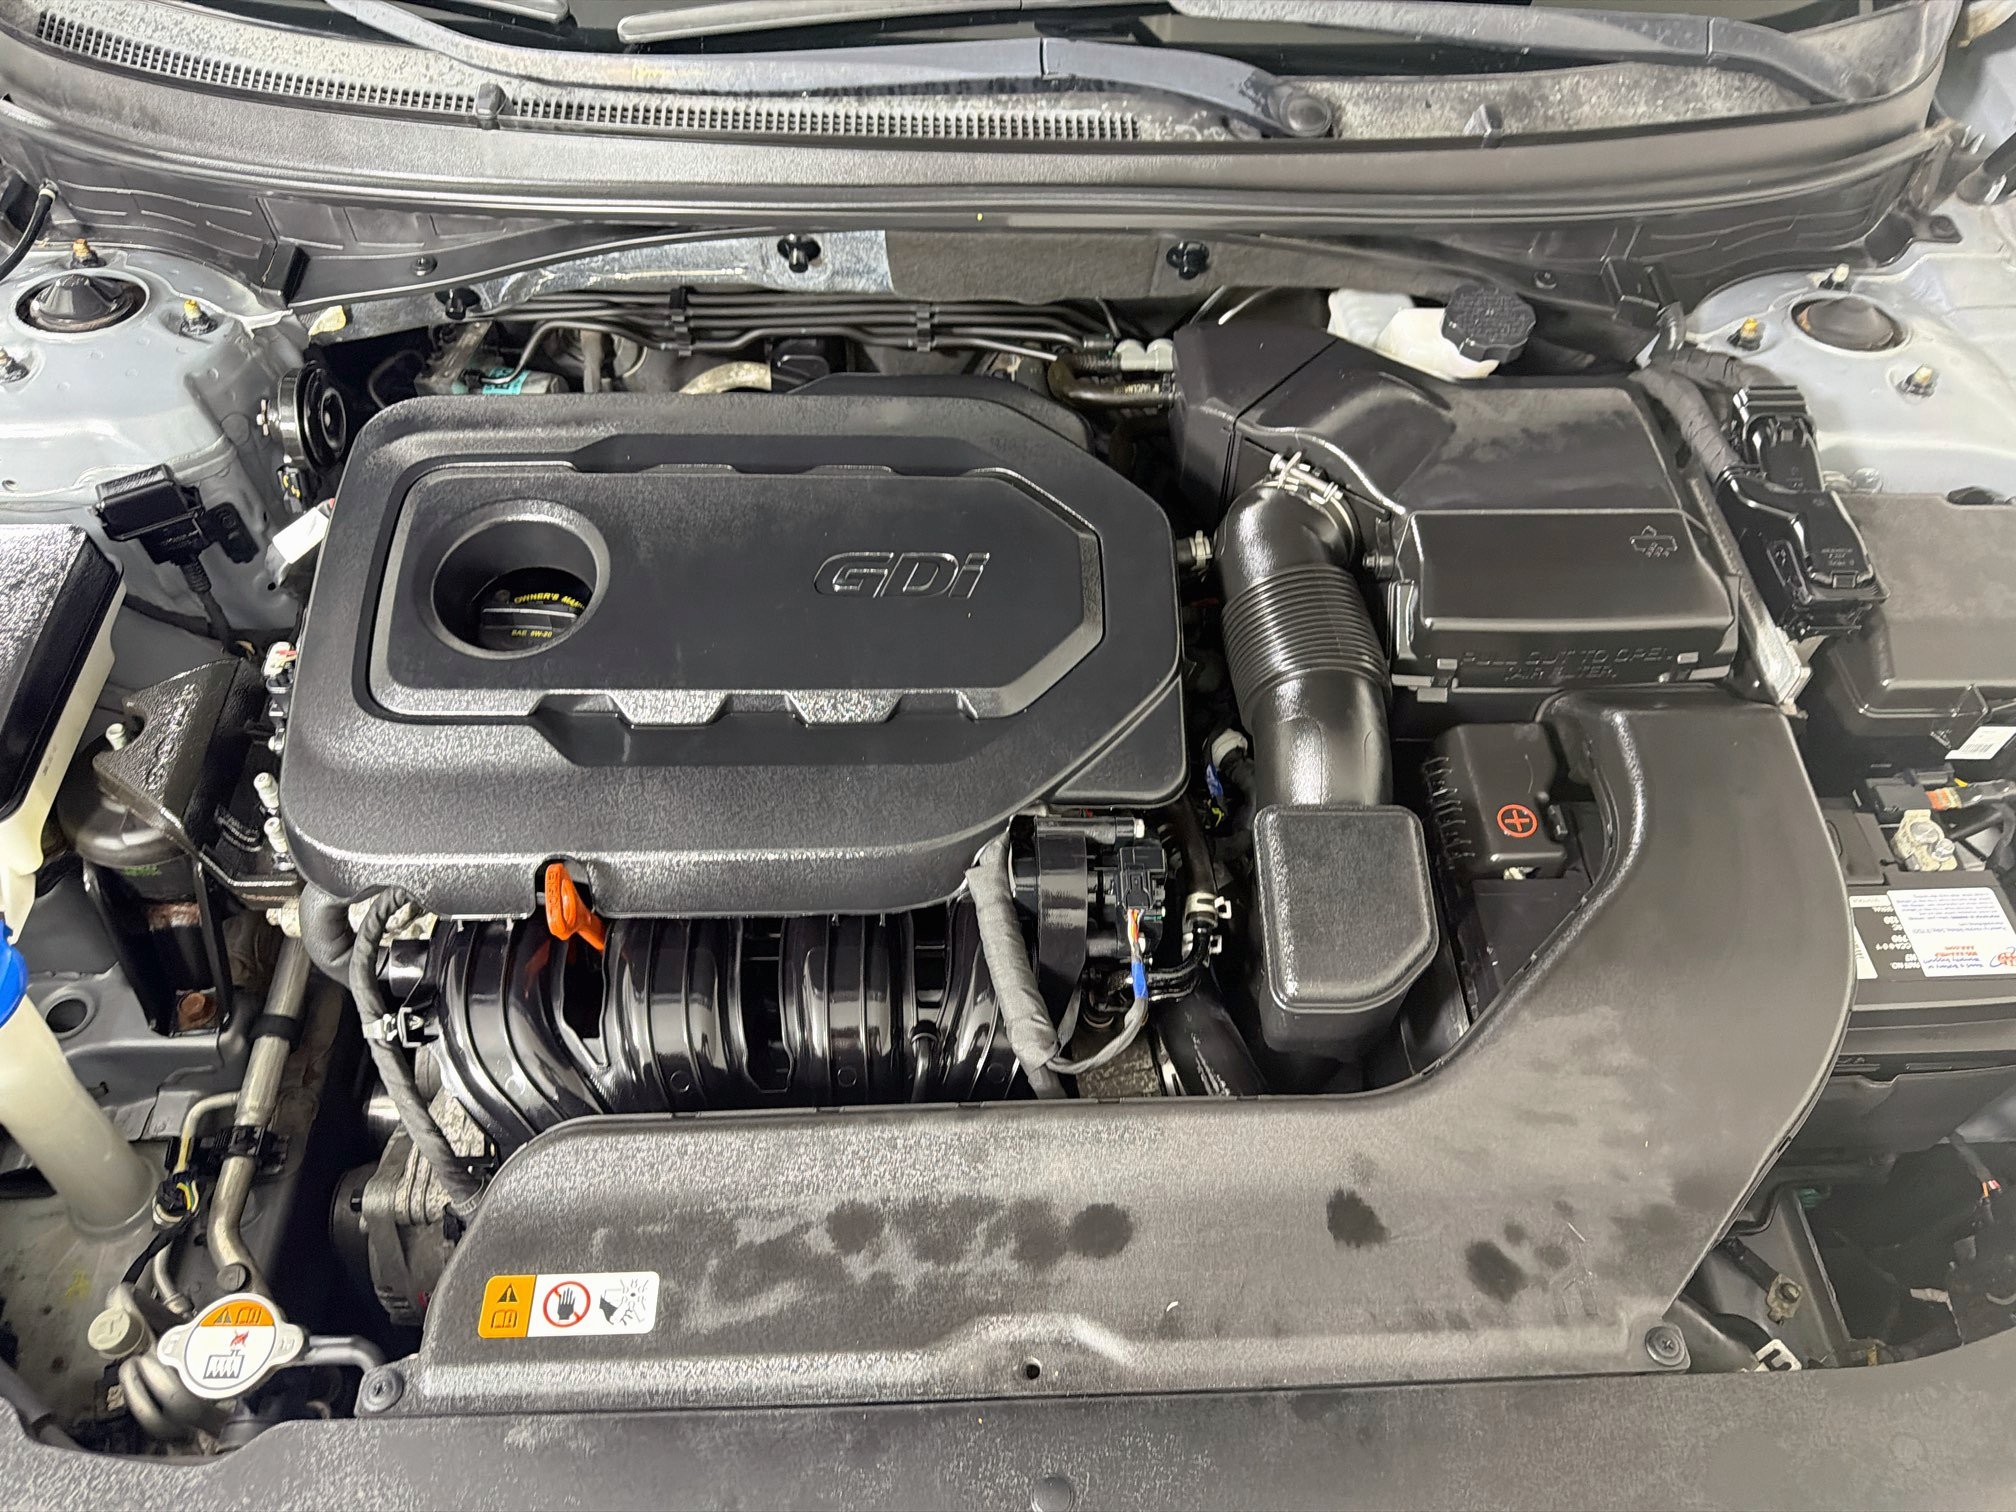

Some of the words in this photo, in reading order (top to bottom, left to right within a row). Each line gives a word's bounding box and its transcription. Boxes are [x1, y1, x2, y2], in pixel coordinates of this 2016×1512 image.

[813, 552, 990, 598] GDi
[514, 592, 559, 604] OWNER'S
[1580, 649, 1608, 664] TO
